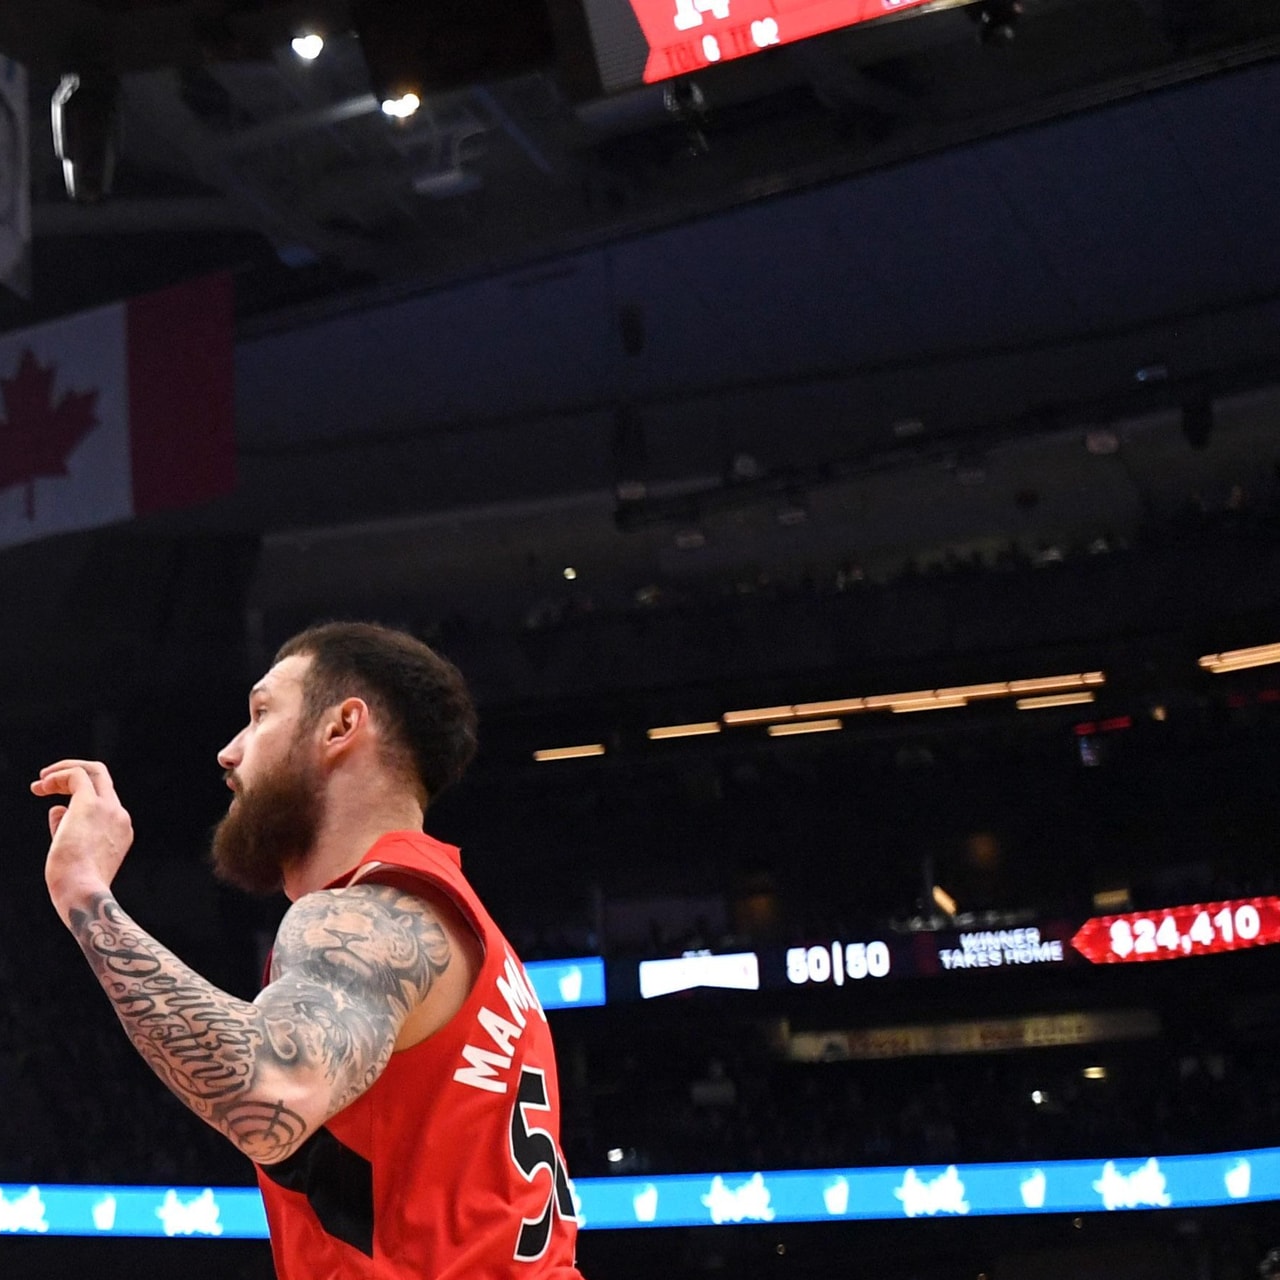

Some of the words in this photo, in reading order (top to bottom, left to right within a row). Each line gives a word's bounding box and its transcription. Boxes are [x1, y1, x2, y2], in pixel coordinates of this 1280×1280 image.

[959, 927, 1041, 952] WINNER
[1109, 904, 1260, 958] $24,410
[939, 945, 1002, 970] TAKES
[1004, 940, 1064, 965] HOME
[509, 1064, 578, 1262] 5
